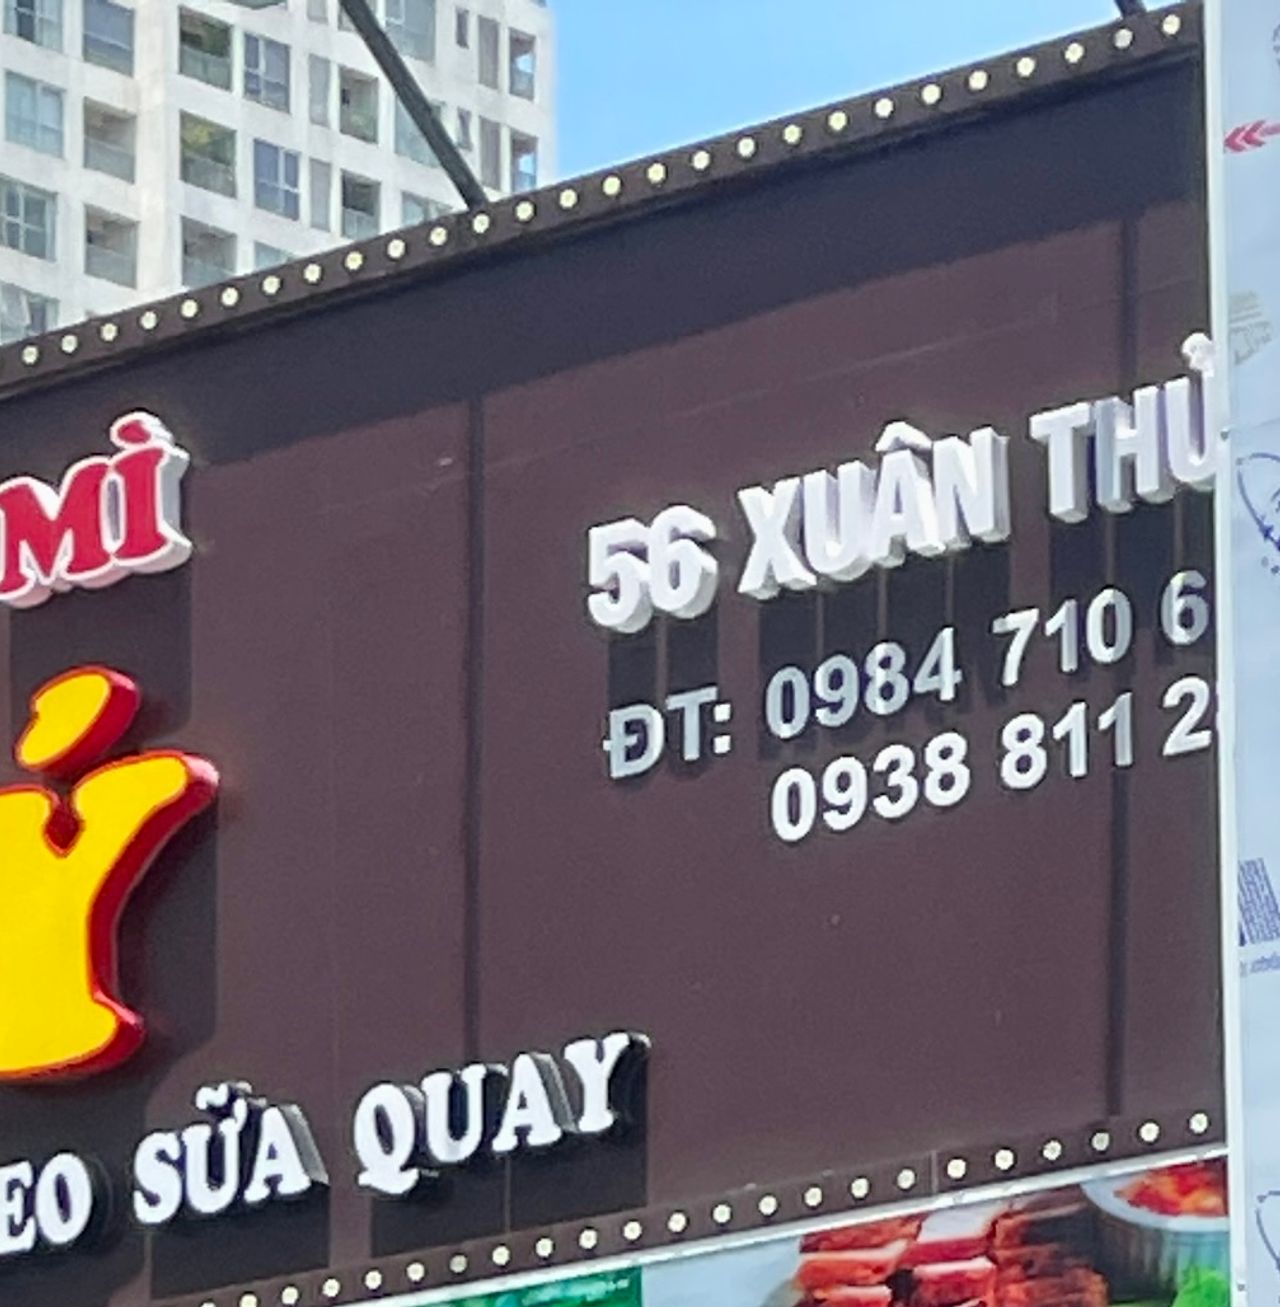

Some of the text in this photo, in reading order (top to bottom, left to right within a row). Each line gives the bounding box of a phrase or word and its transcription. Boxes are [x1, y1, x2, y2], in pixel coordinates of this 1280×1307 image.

[587, 505, 718, 633] 56
[738, 420, 1010, 599] XUÂN
[603, 687, 732, 779] ĐT:
[765, 627, 962, 740] 0984
[992, 589, 1132, 687] 710
[771, 731, 969, 842] 0938
[1000, 692, 1134, 789] 811
[133, 1083, 314, 1226] SỮA
[353, 1032, 640, 1193] QUAY
